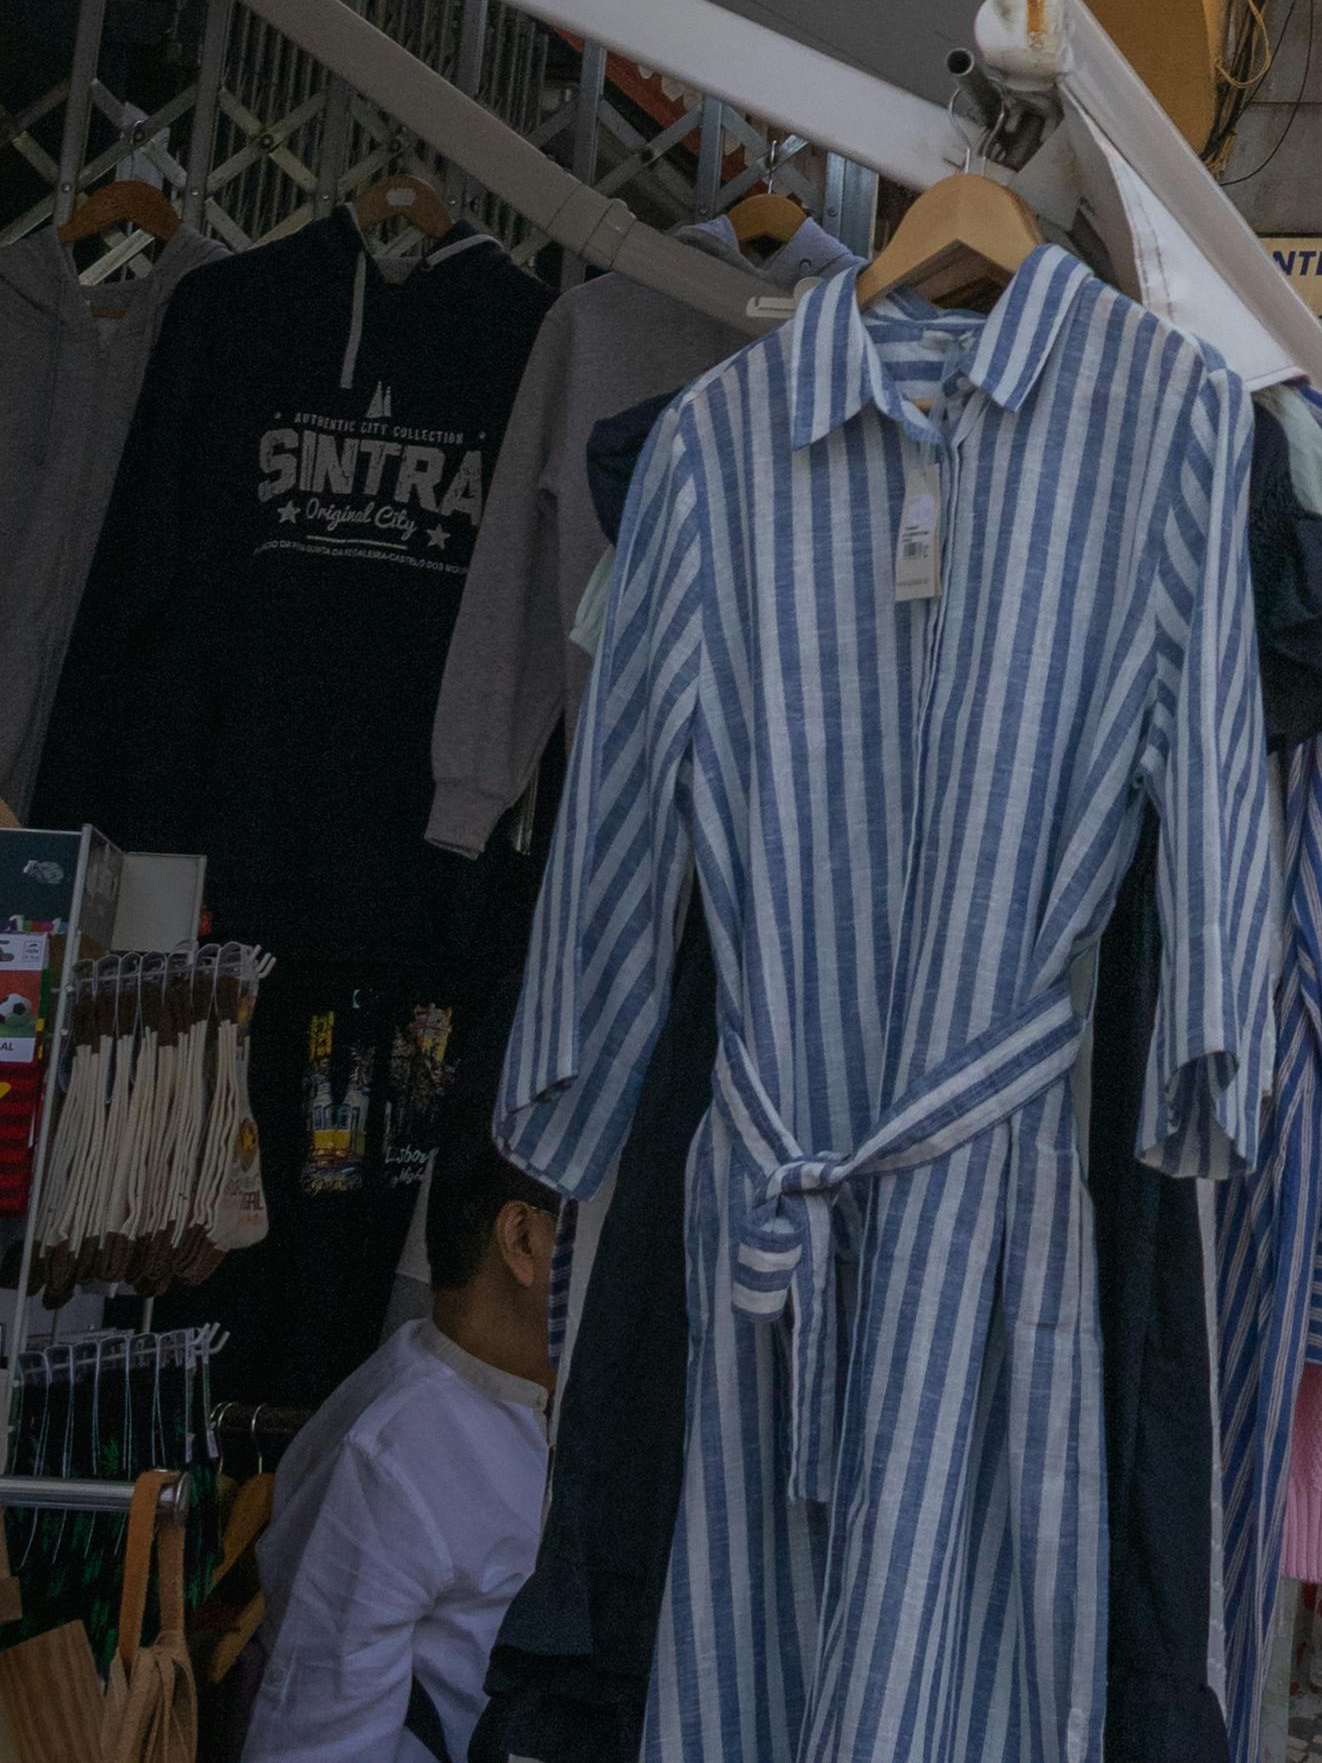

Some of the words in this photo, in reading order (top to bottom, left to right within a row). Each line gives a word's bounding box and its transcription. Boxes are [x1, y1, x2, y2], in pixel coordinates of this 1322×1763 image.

[293, 411, 356, 433] AUTHENTIC
[360, 422, 388, 437] CITY
[392, 425, 464, 444] COLLECTION
[258, 428, 485, 527] SINTRA
[305, 497, 371, 532] Original
[374, 505, 418, 542] City
